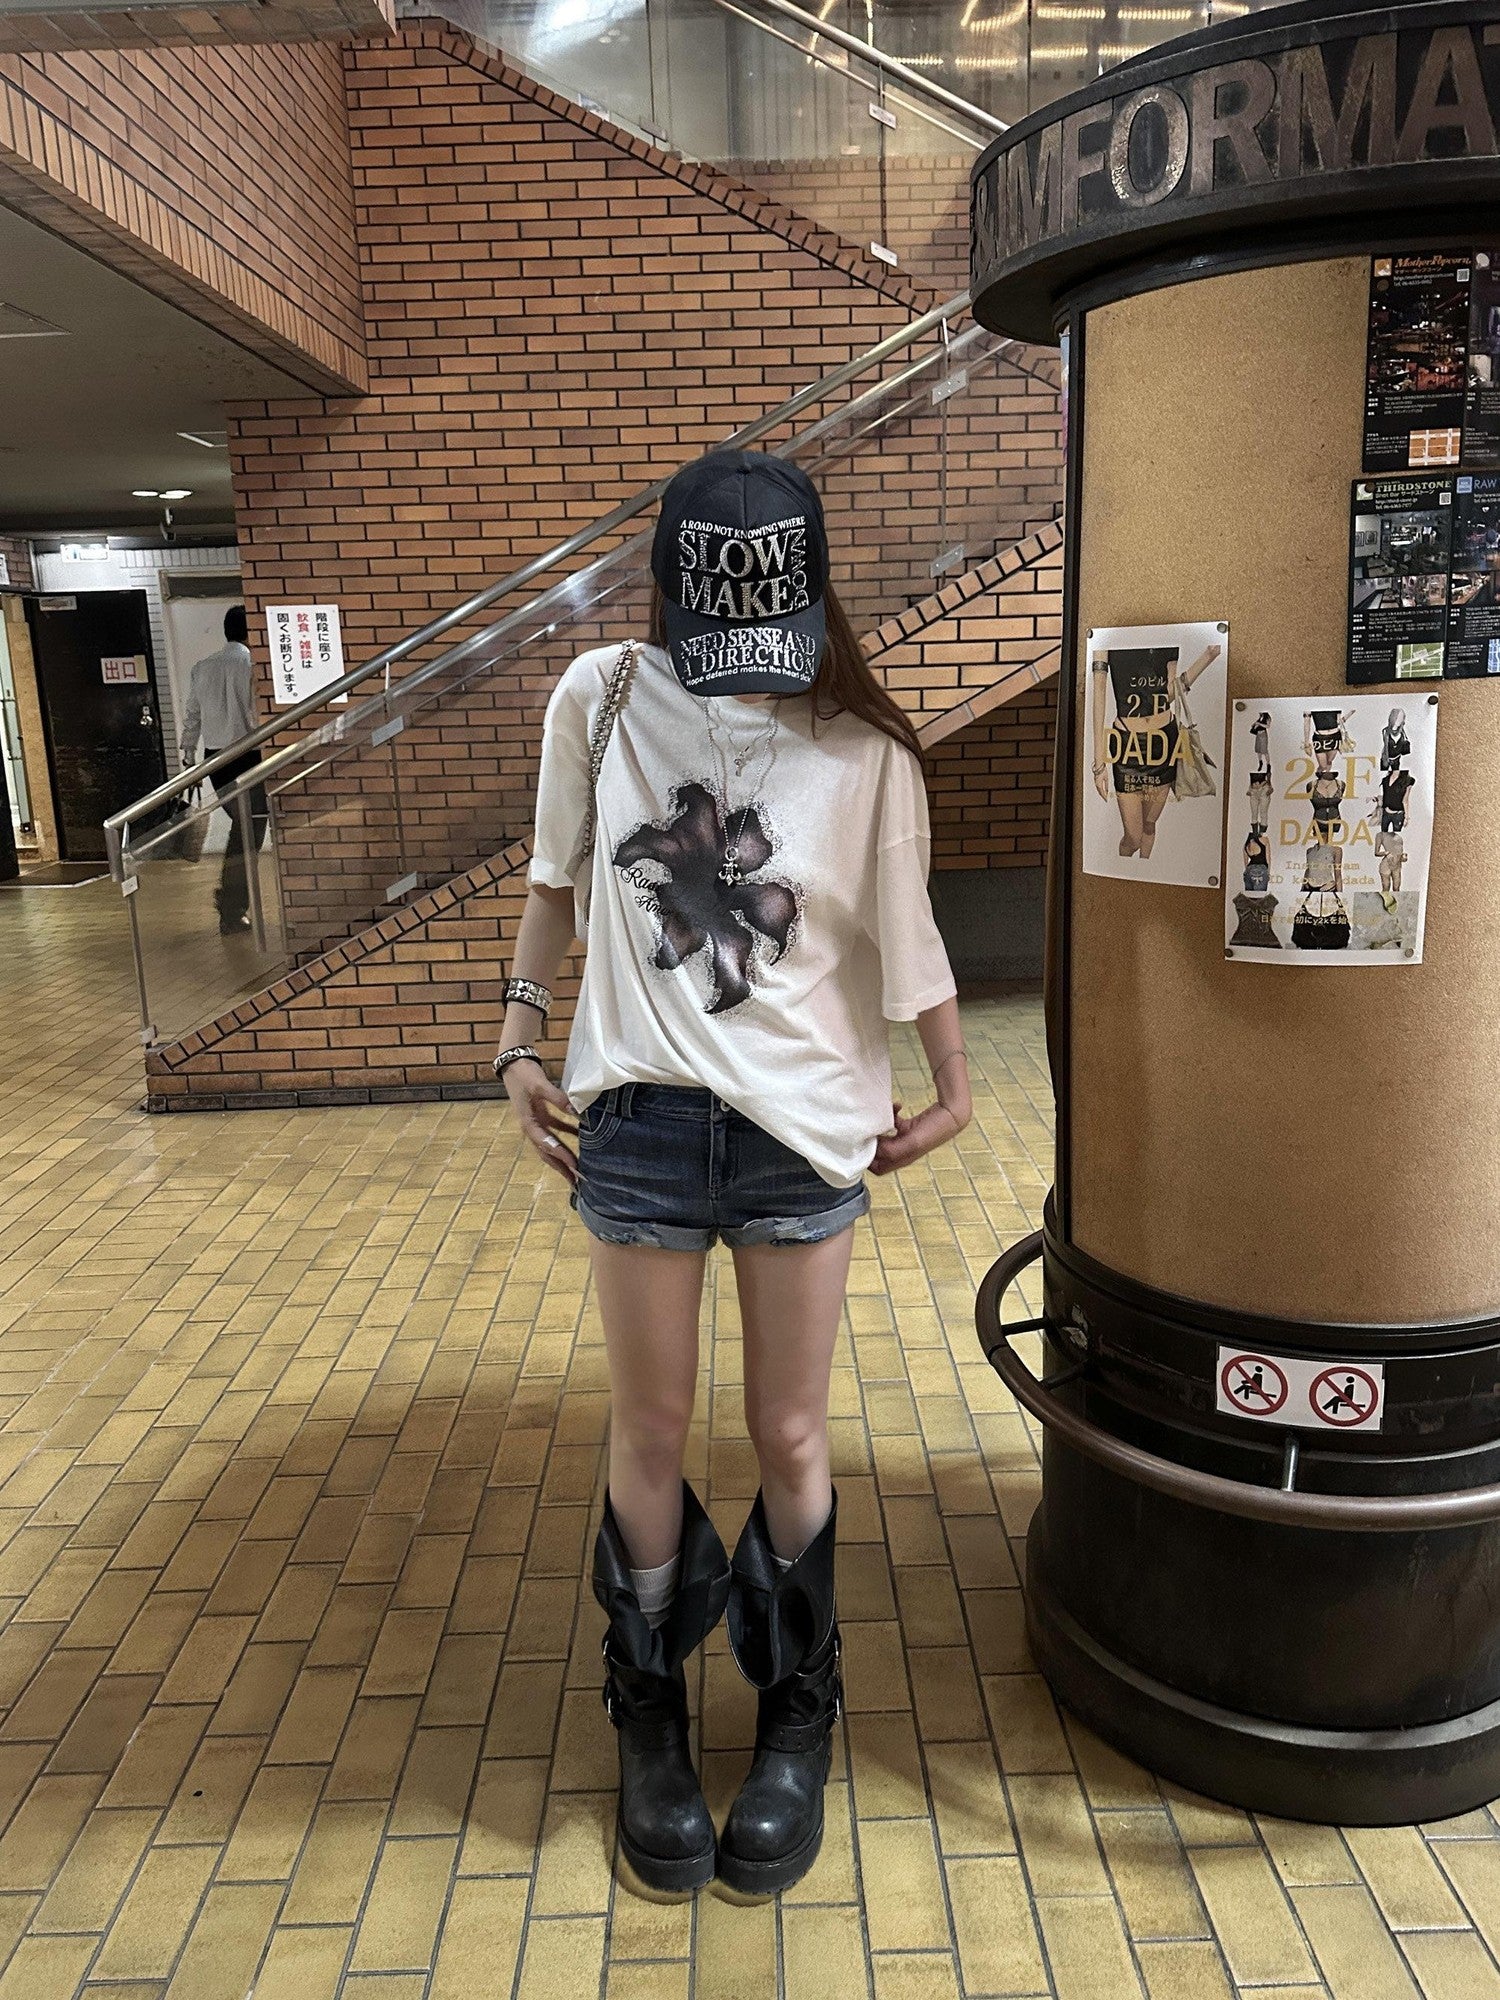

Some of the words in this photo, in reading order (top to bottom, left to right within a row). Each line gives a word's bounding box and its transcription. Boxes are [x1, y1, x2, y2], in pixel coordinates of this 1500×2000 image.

[997, 22, 1500, 258] IMFORMA
[1375, 481, 1453, 493] THIRDSTONE
[1473, 479, 1497, 489] RAW
[680, 519, 687, 529] A
[688, 520, 713, 532] ROAD
[713, 524, 734, 537] NOT
[734, 522, 779, 540] KNOWING
[777, 516, 806, 530] WHERE
[678, 529, 790, 578] SLOW
[681, 572, 794, 619] MAKE
[296, 613, 313, 669] 飲食・雑談は
[315, 612, 332, 662] 階段に座り
[680, 631, 726, 660] NEED
[727, 626, 783, 647] SENSE
[105, 661, 137, 681] 出口
[277, 613, 298, 697] 固くお断りします。
[701, 645, 815, 676] DIRECTION
[740, 664, 768, 673] makes
[1129, 675, 1166, 687] このビル
[1103, 727, 1195, 767] DADA
[1279, 819, 1374, 846] DADA
